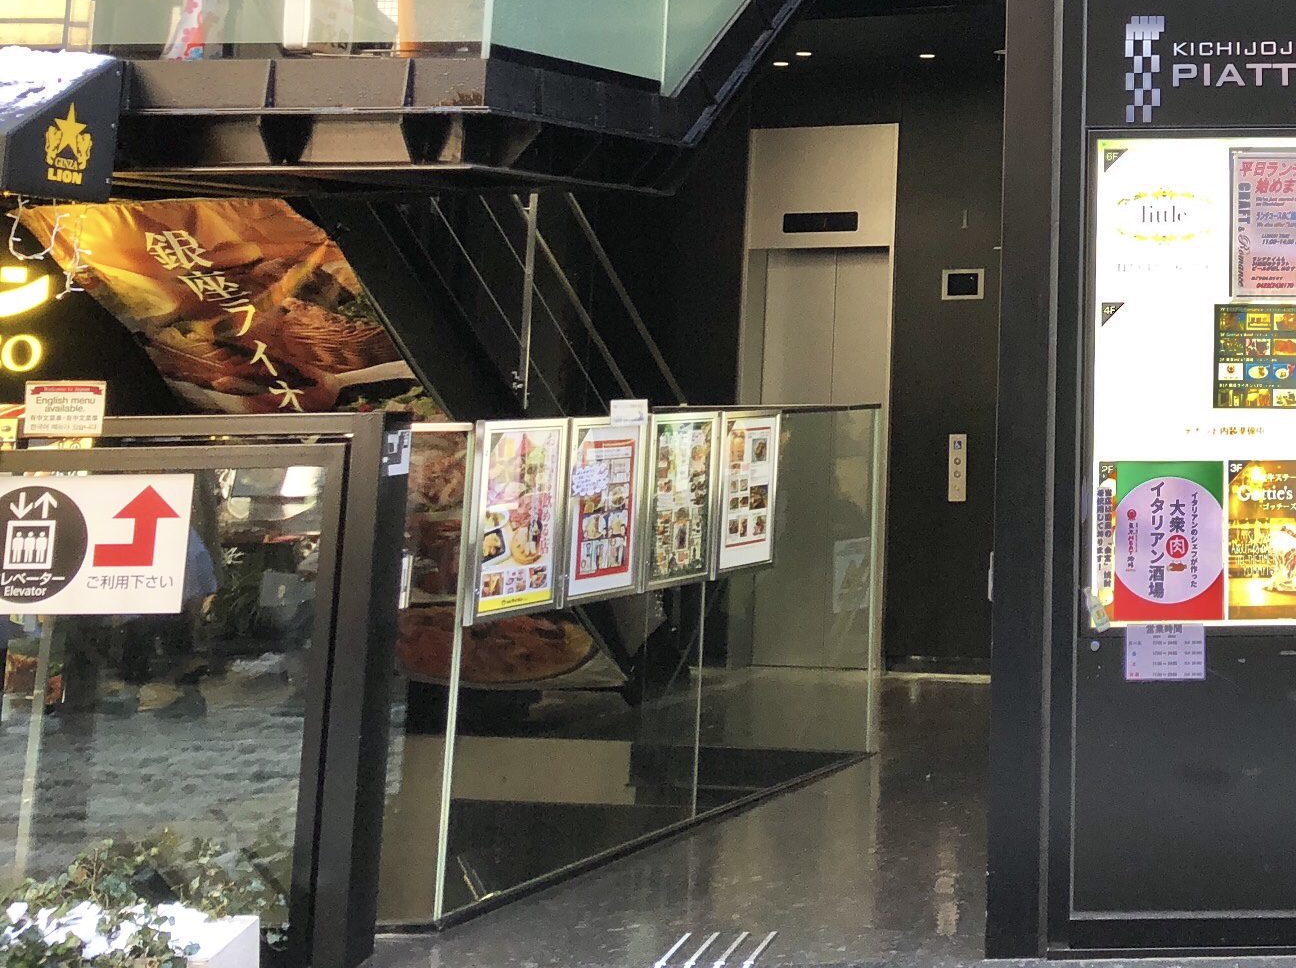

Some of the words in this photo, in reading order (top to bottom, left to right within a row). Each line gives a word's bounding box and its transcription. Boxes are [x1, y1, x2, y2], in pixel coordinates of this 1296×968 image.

[54, 156, 80, 171] GINZA
[1105, 152, 1118, 161] 6F
[47, 170, 82, 185] LION
[1237, 182, 1251, 224] CRAFT
[1142, 205, 1187, 223] little
[1103, 305, 1116, 315] 4F
[36, 396, 69, 406] English
[71, 397, 96, 405] menu
[1230, 464, 1243, 472] 3F
[1149, 481, 1165, 599] イタリアン酒場
[0, 571, 65, 586] レベーター
[86, 575, 174, 590] ご利用下さい
[4, 586, 47, 597] Elevator
